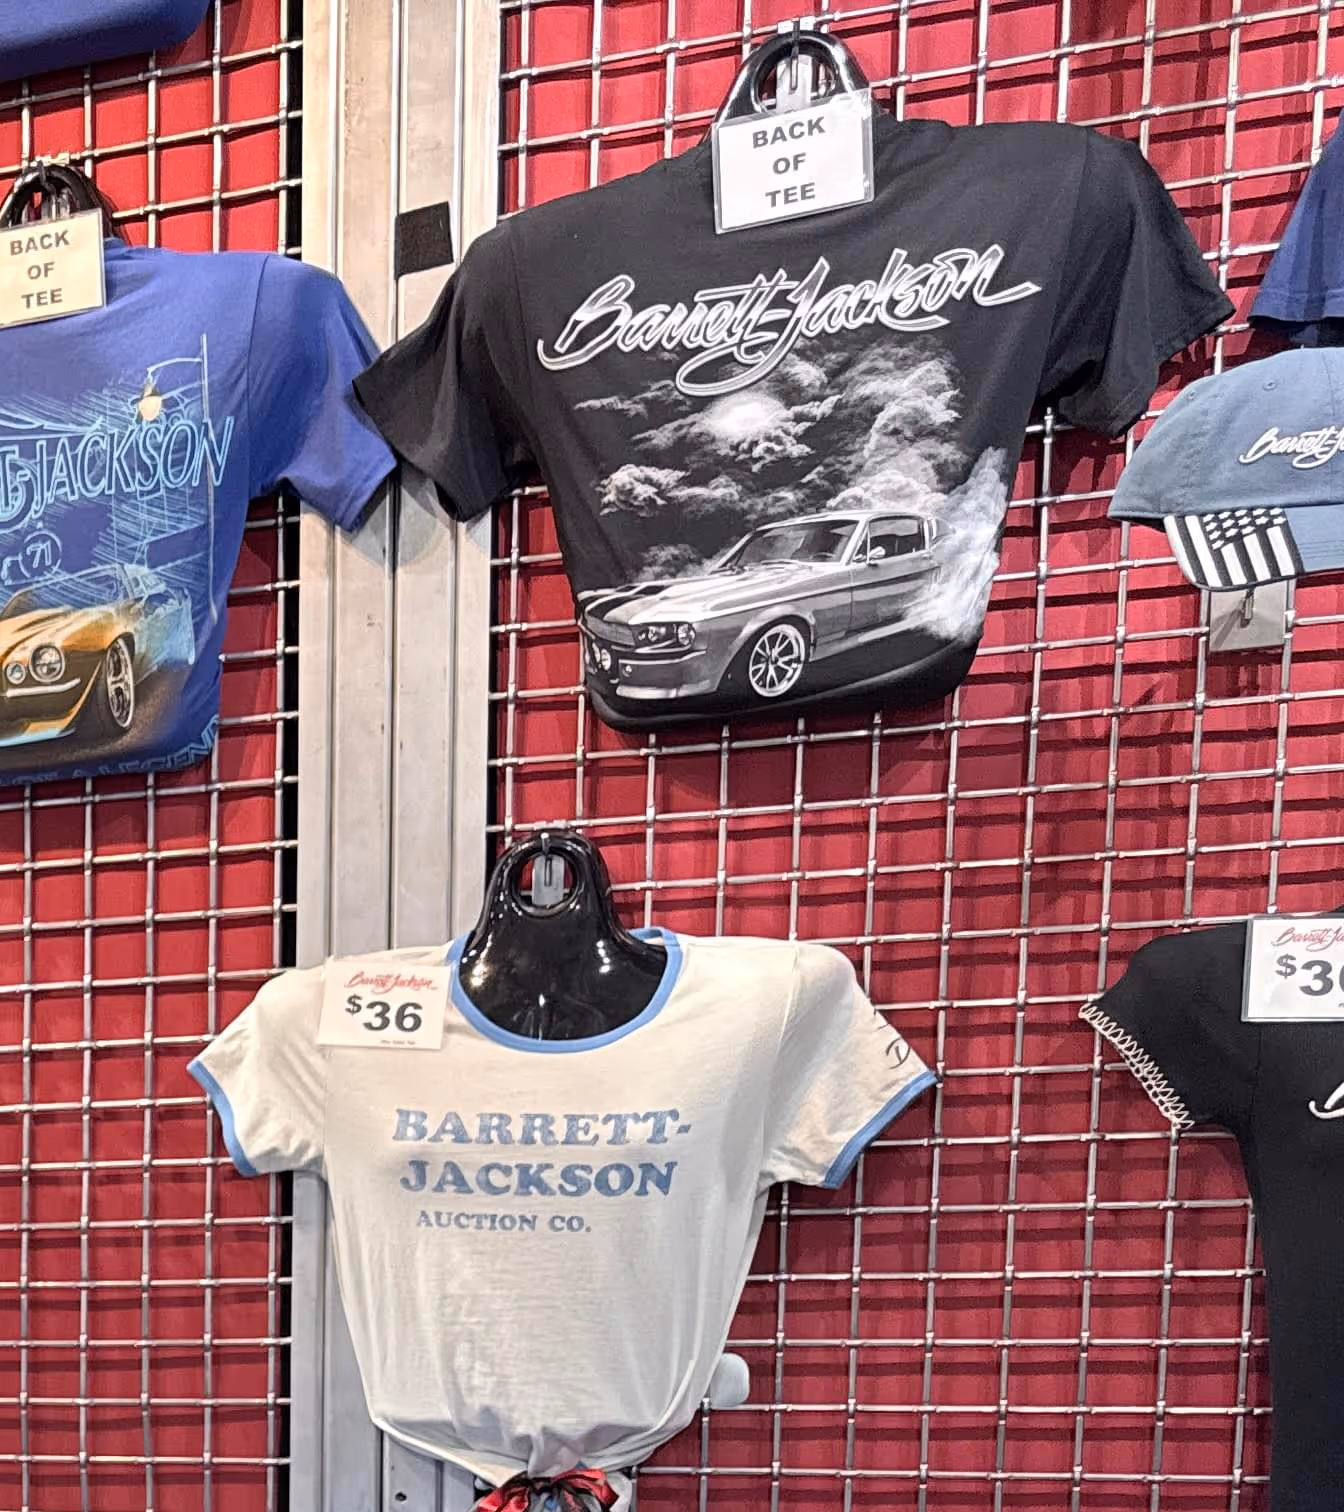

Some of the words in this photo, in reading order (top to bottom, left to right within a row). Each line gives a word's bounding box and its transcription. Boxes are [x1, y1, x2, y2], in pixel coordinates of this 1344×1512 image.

[752, 114, 827, 150] BACK
[772, 151, 808, 176] OF
[765, 181, 818, 209] TEE
[9, 229, 71, 258] BACK
[26, 261, 56, 281] OF
[20, 288, 64, 310] TEE
[538, 244, 1042, 396] Barrett-Jackson
[344, 993, 424, 1034] $36
[390, 1106, 693, 1148] BARRETT-
[400, 1158, 679, 1199] JACKSON
[416, 1209, 540, 1234] AUCTION
[547, 1211, 593, 1235] CO.
